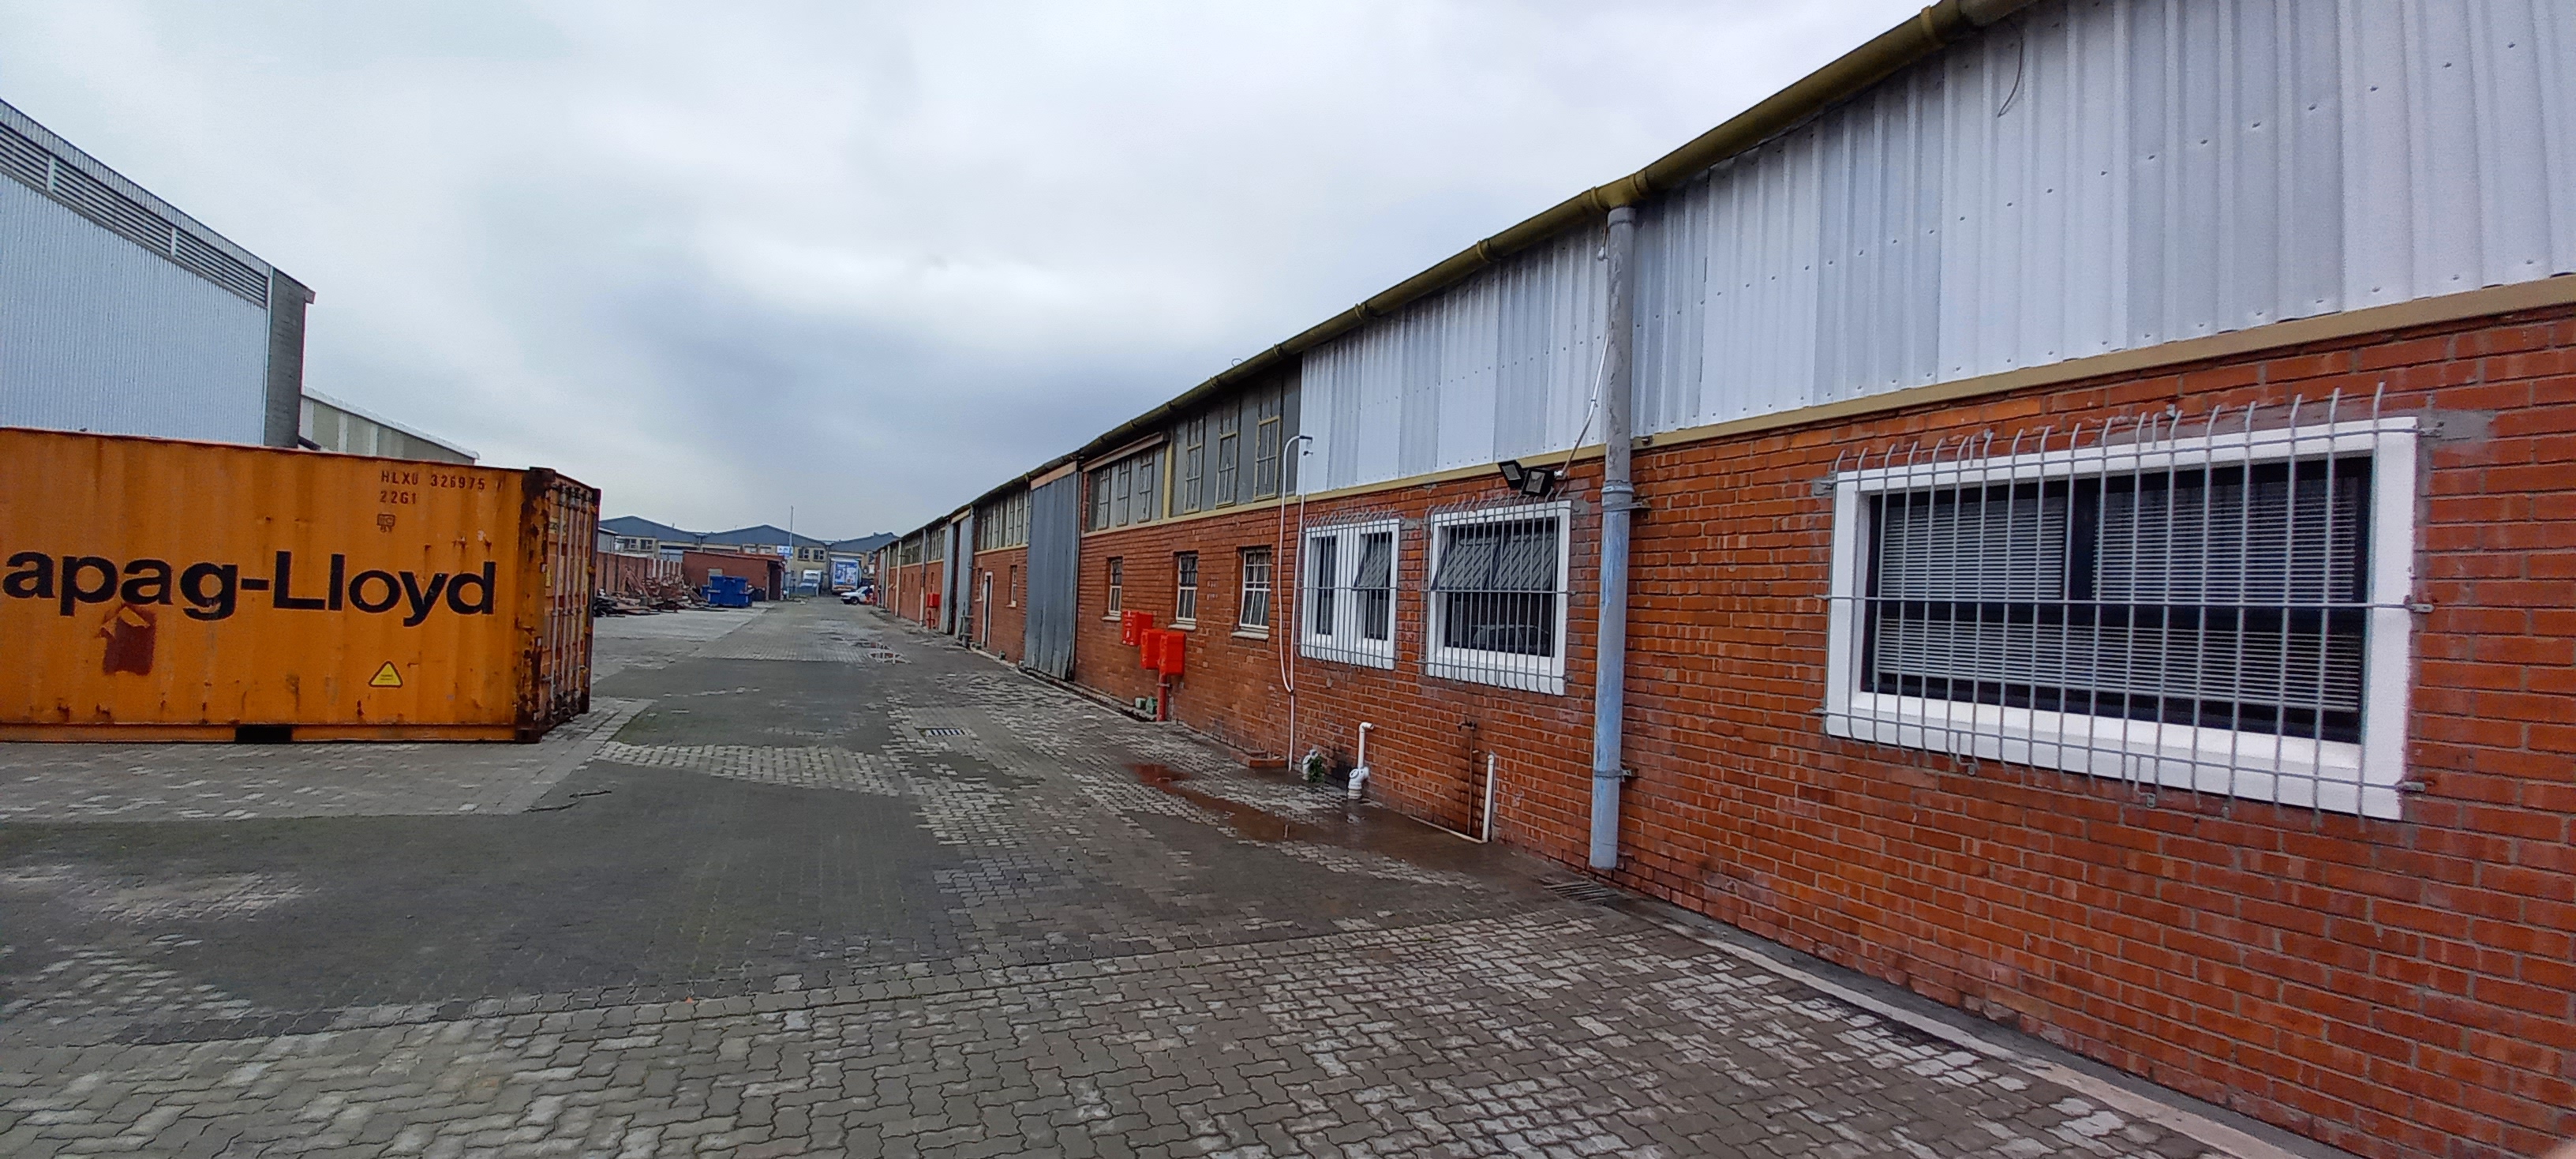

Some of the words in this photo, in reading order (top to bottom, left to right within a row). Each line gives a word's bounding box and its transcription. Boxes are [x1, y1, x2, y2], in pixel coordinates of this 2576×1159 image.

[381, 470, 419, 486] HLXU
[430, 474, 485, 490] 326975
[380, 490, 417, 504] 22G1
[2, 550, 496, 628] apag-Lloyd
